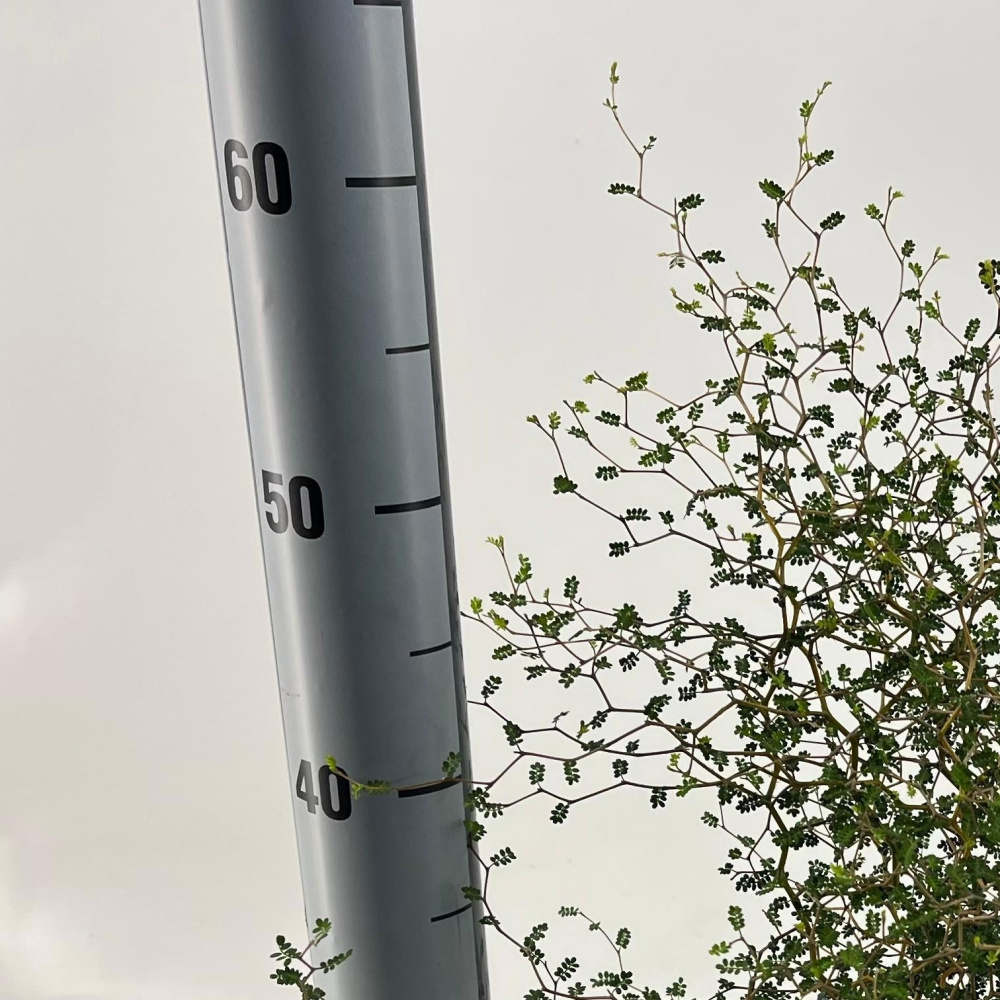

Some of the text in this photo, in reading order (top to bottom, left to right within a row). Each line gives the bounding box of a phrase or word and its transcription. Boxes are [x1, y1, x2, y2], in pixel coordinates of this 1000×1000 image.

[223, 138, 293, 216] 60
[260, 468, 326, 540] 50
[295, 758, 353, 821] 40
